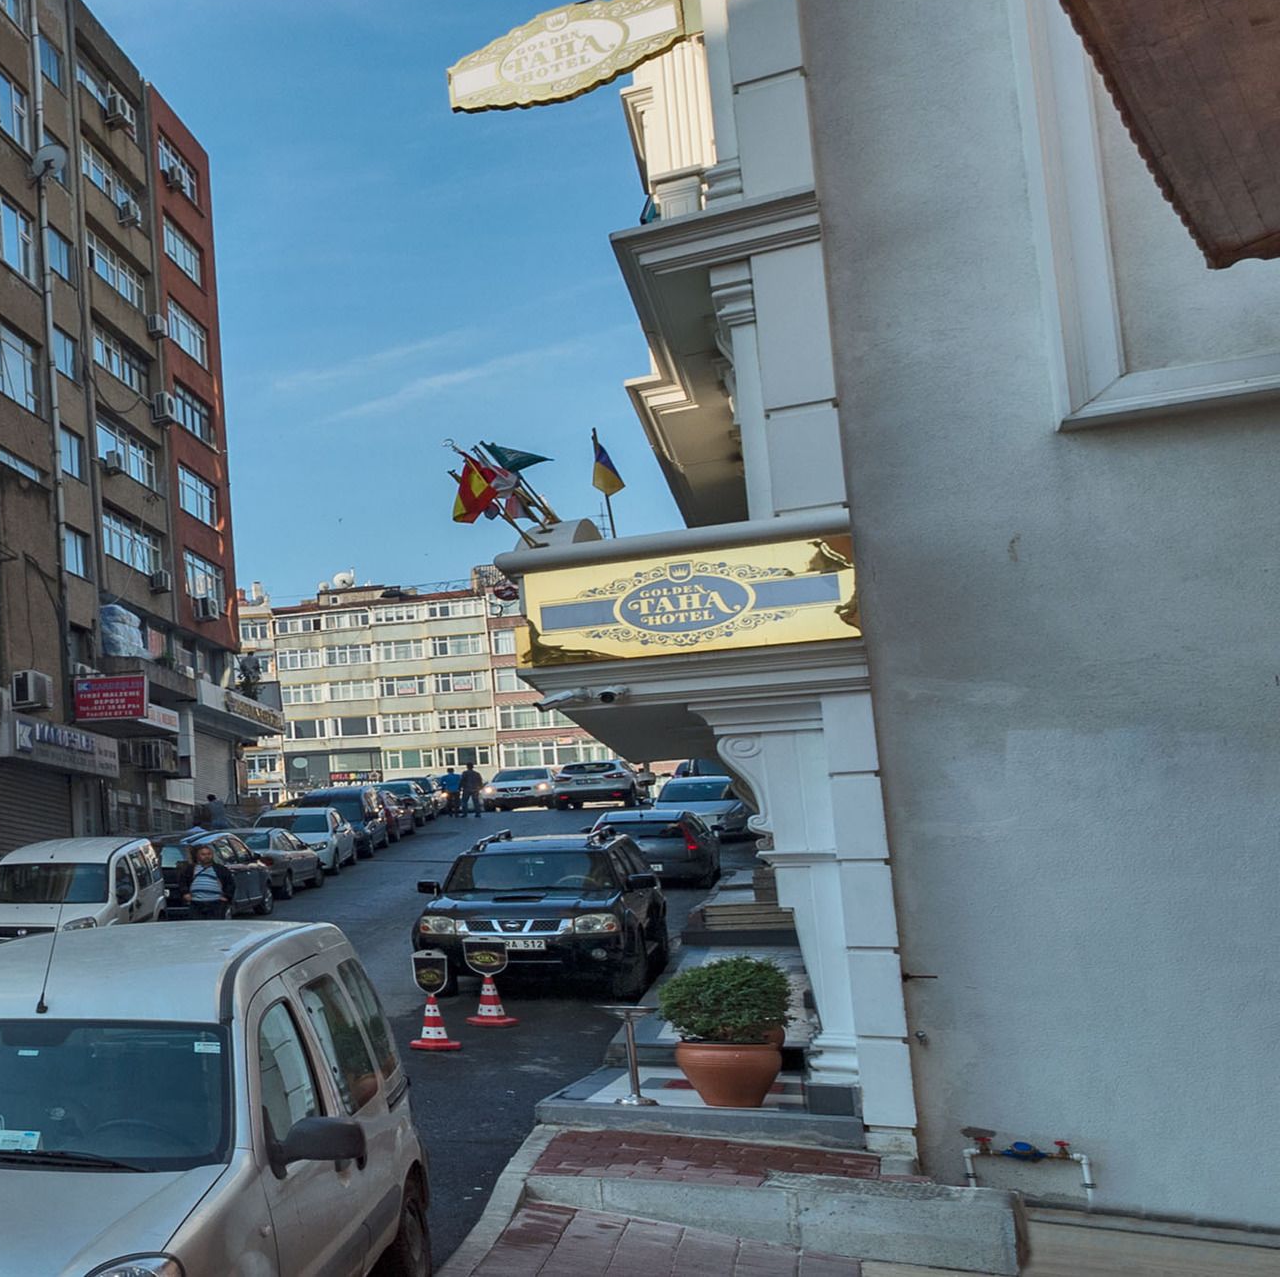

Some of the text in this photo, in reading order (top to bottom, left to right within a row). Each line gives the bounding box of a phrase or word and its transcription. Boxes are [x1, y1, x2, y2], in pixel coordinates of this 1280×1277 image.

[504, 35, 616, 74] TAHA
[515, 31, 587, 56] GOLDEN
[514, 54, 591, 82] HOTEL
[628, 591, 741, 615] TAHA
[640, 584, 711, 598] GOLDEN
[640, 610, 715, 626] HOTEL
[524, 940, 543, 948] 512
